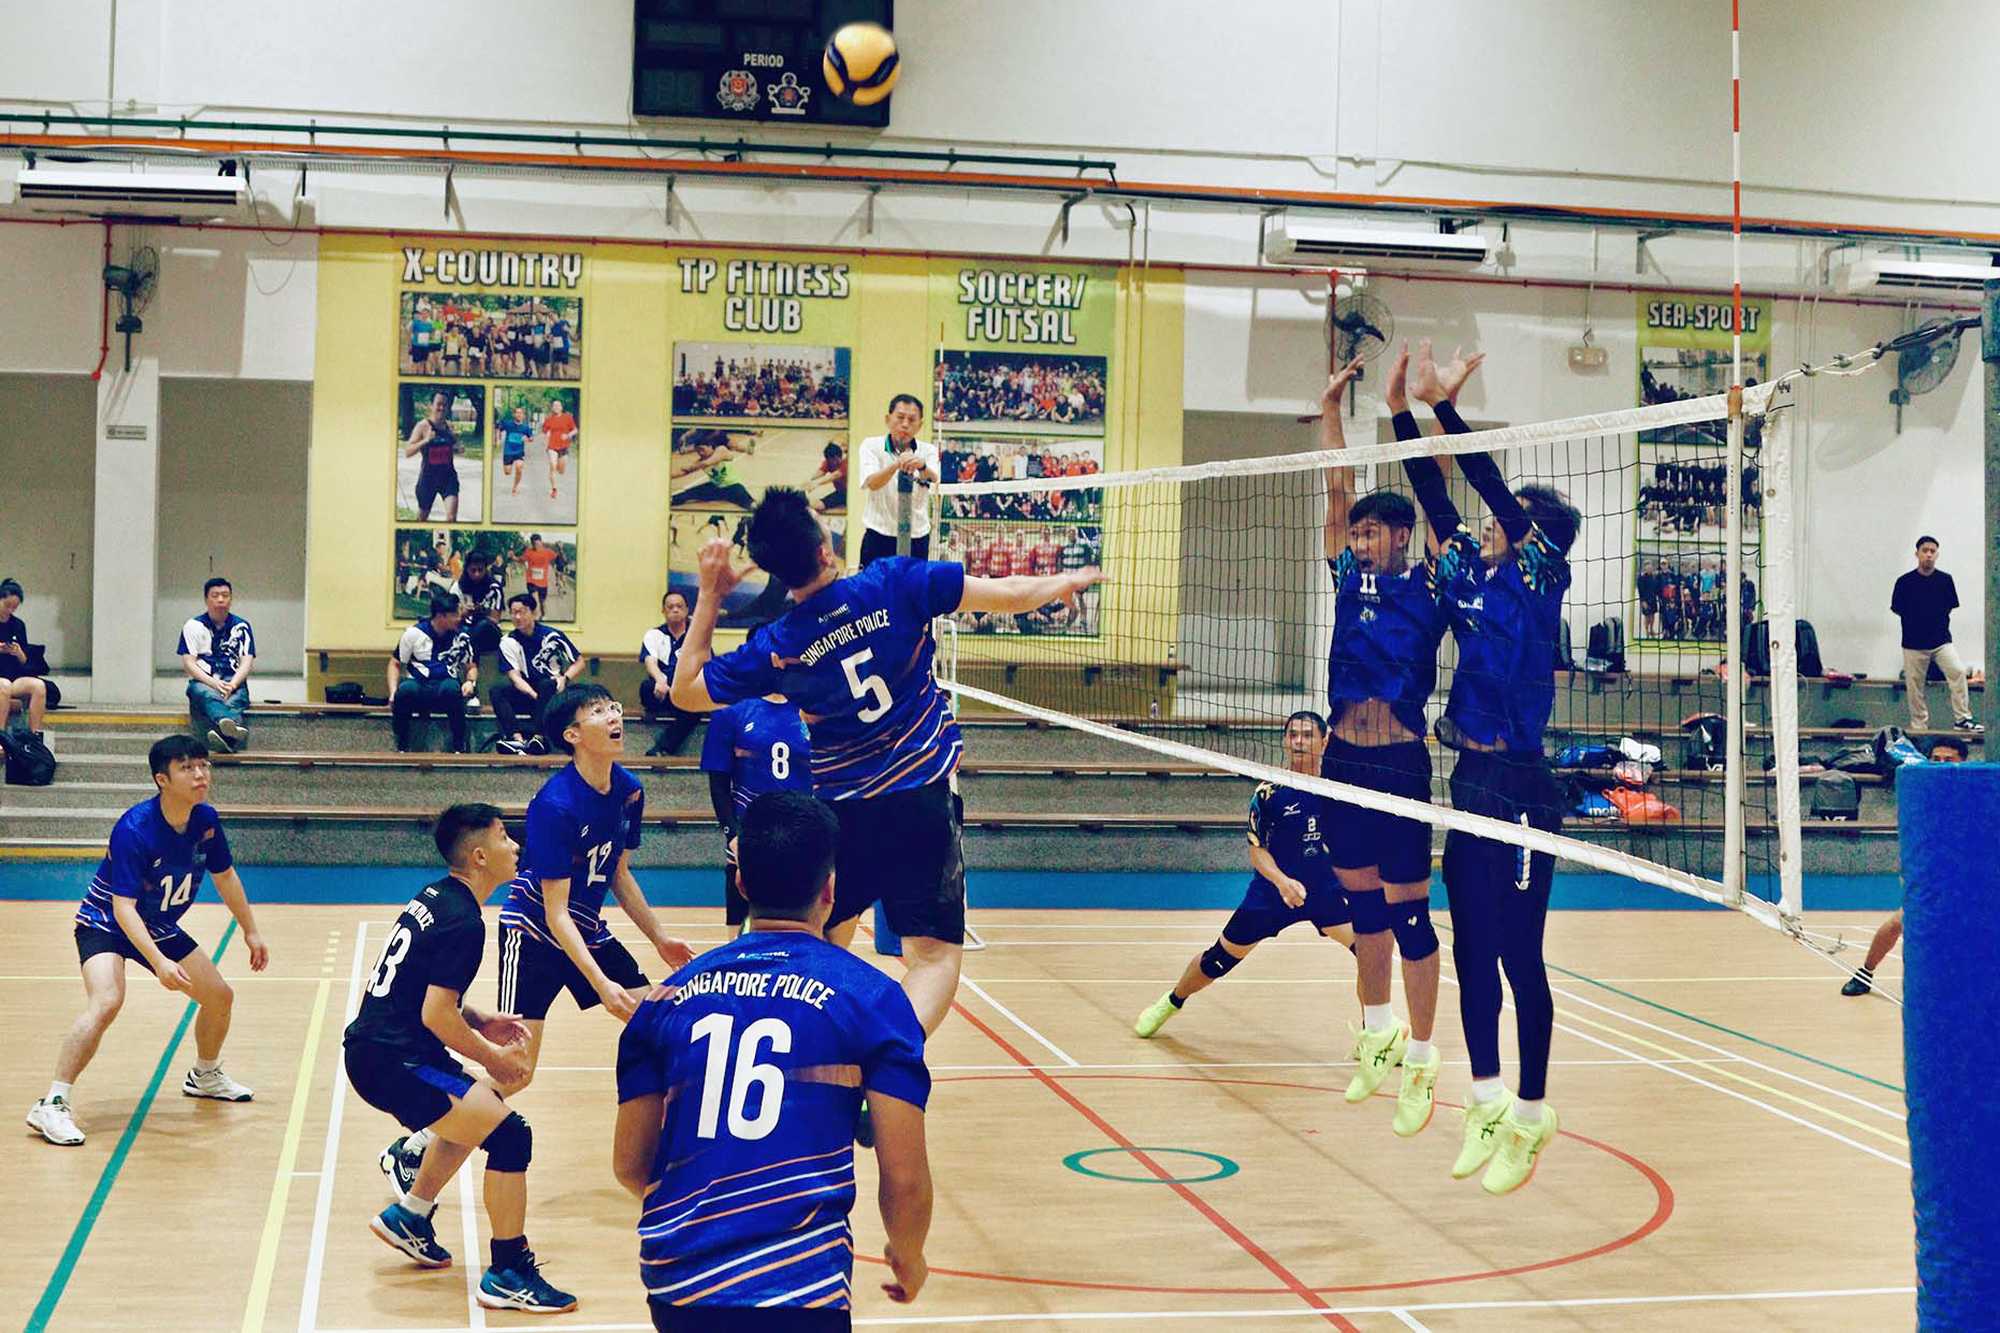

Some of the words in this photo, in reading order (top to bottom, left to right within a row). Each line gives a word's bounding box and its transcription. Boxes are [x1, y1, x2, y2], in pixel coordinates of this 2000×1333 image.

[743, 53, 784, 67] PERIOD
[402, 248, 581, 288] X-COUNTRY
[679, 257, 717, 292] TP
[727, 260, 849, 298] FITNESS
[959, 269, 1087, 309] SOCCER/
[725, 296, 802, 332] CLUB
[967, 306, 1076, 344] FUTSAL
[800, 622, 858, 667] SINGAPORE
[855, 608, 891, 637] POLICE
[840, 646, 893, 723] 5
[771, 741, 790, 780] 8
[586, 841, 612, 887] 12
[160, 872, 193, 912] 14
[673, 971, 771, 1006] SINGAPORE
[771, 973, 836, 1010] POLICE
[690, 1013, 792, 1141] 16
